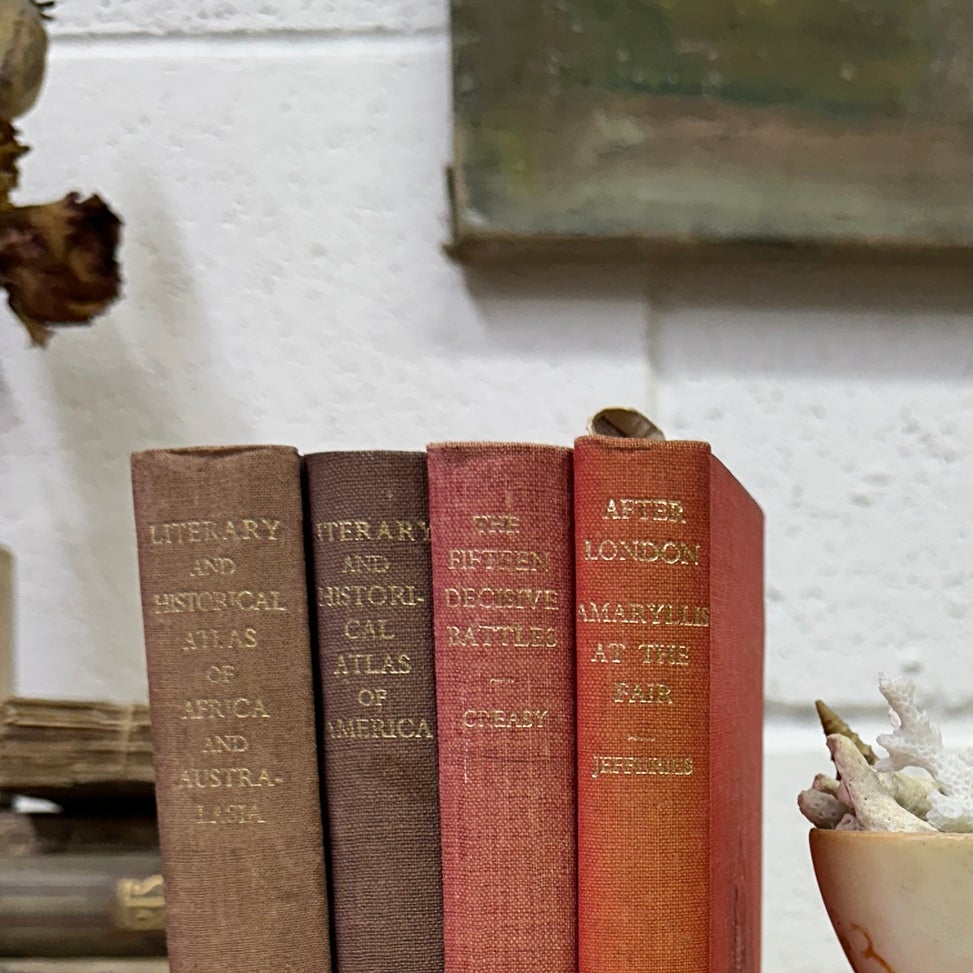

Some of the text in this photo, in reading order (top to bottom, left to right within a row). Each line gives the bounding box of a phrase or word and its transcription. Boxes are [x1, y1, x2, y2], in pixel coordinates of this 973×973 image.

[601, 499, 686, 524] AFTER
[150, 519, 280, 544] LITERARY
[473, 515, 520, 534] THE
[448, 550, 550, 572] FIFTEEN
[585, 540, 701, 566] LONDON
[190, 557, 237, 577] AND
[341, 555, 390, 574] AND
[445, 588, 559, 610] DECISIVE
[344, 619, 395, 640] CAL
[447, 626, 558, 648] BATTLES
[333, 653, 413, 675] ATLAS
[591, 643, 690, 666] AT THE
[206, 665, 235, 684] OF
[358, 688, 388, 707] OF
[614, 683, 673, 704] FAIR
[462, 710, 549, 728] CREASY
[202, 734, 249, 753] AND
